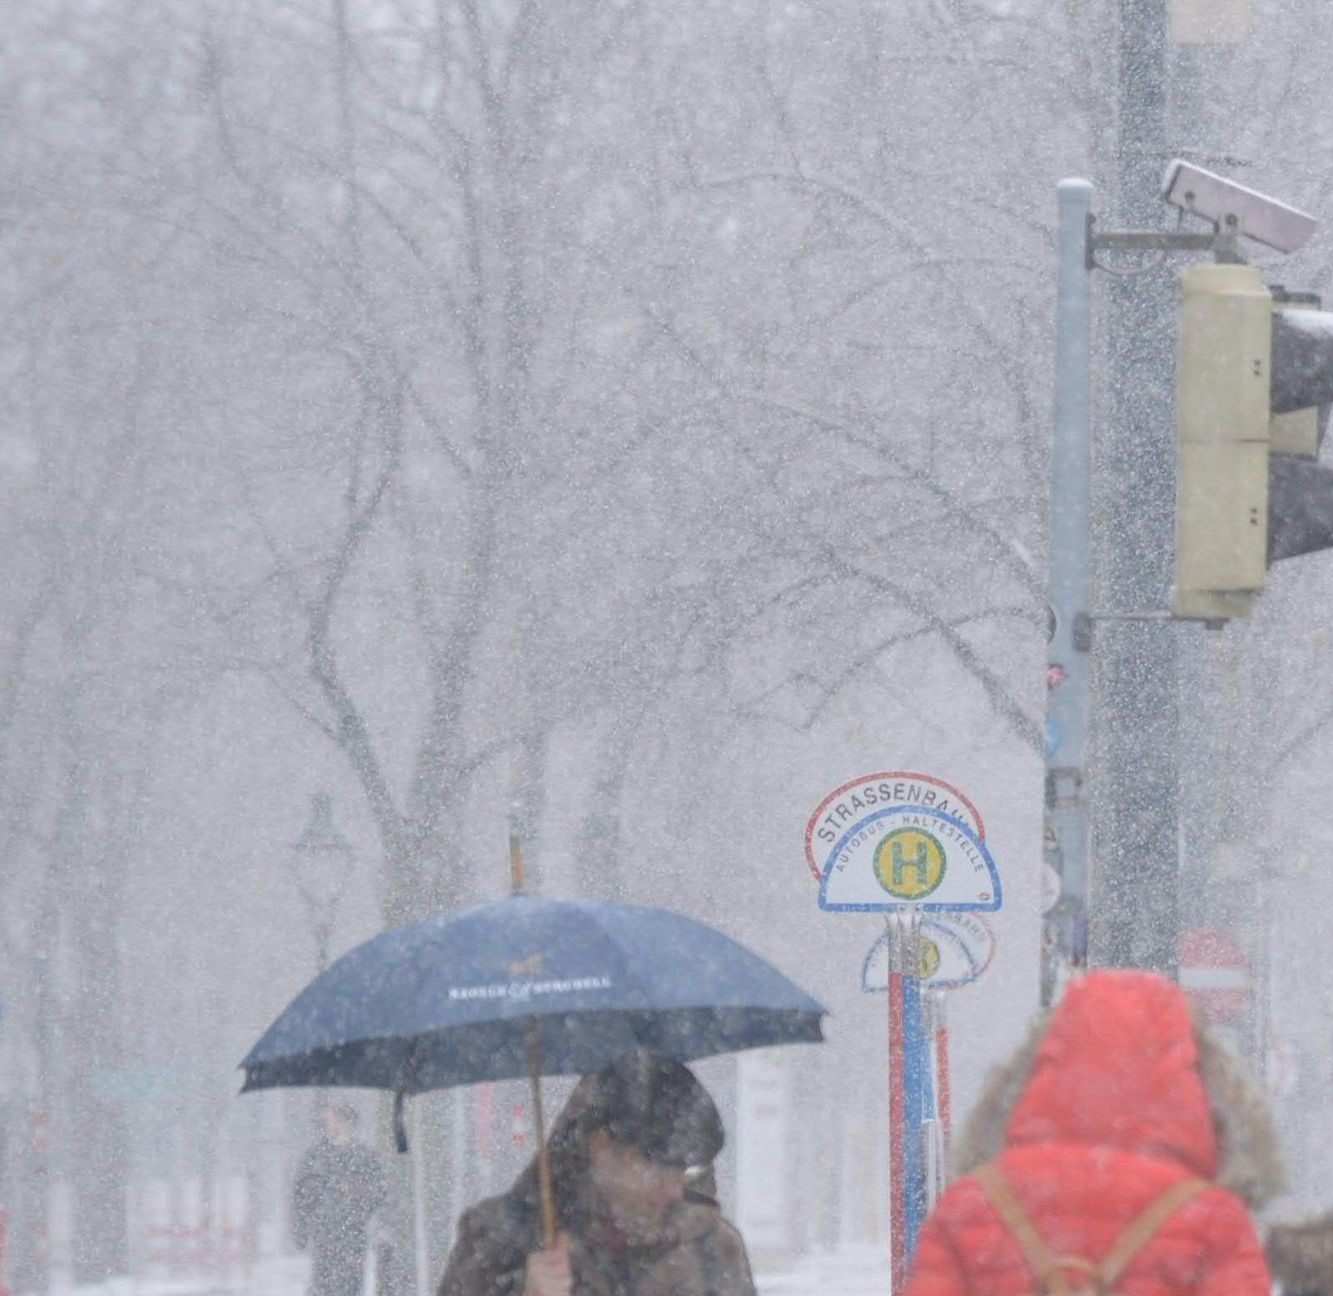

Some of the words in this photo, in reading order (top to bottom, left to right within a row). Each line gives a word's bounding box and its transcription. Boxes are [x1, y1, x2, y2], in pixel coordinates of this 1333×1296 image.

[836, 821, 886, 873] AUTOBUS
[903, 815, 985, 873] HALTESTELLE
[892, 841, 928, 885] H
